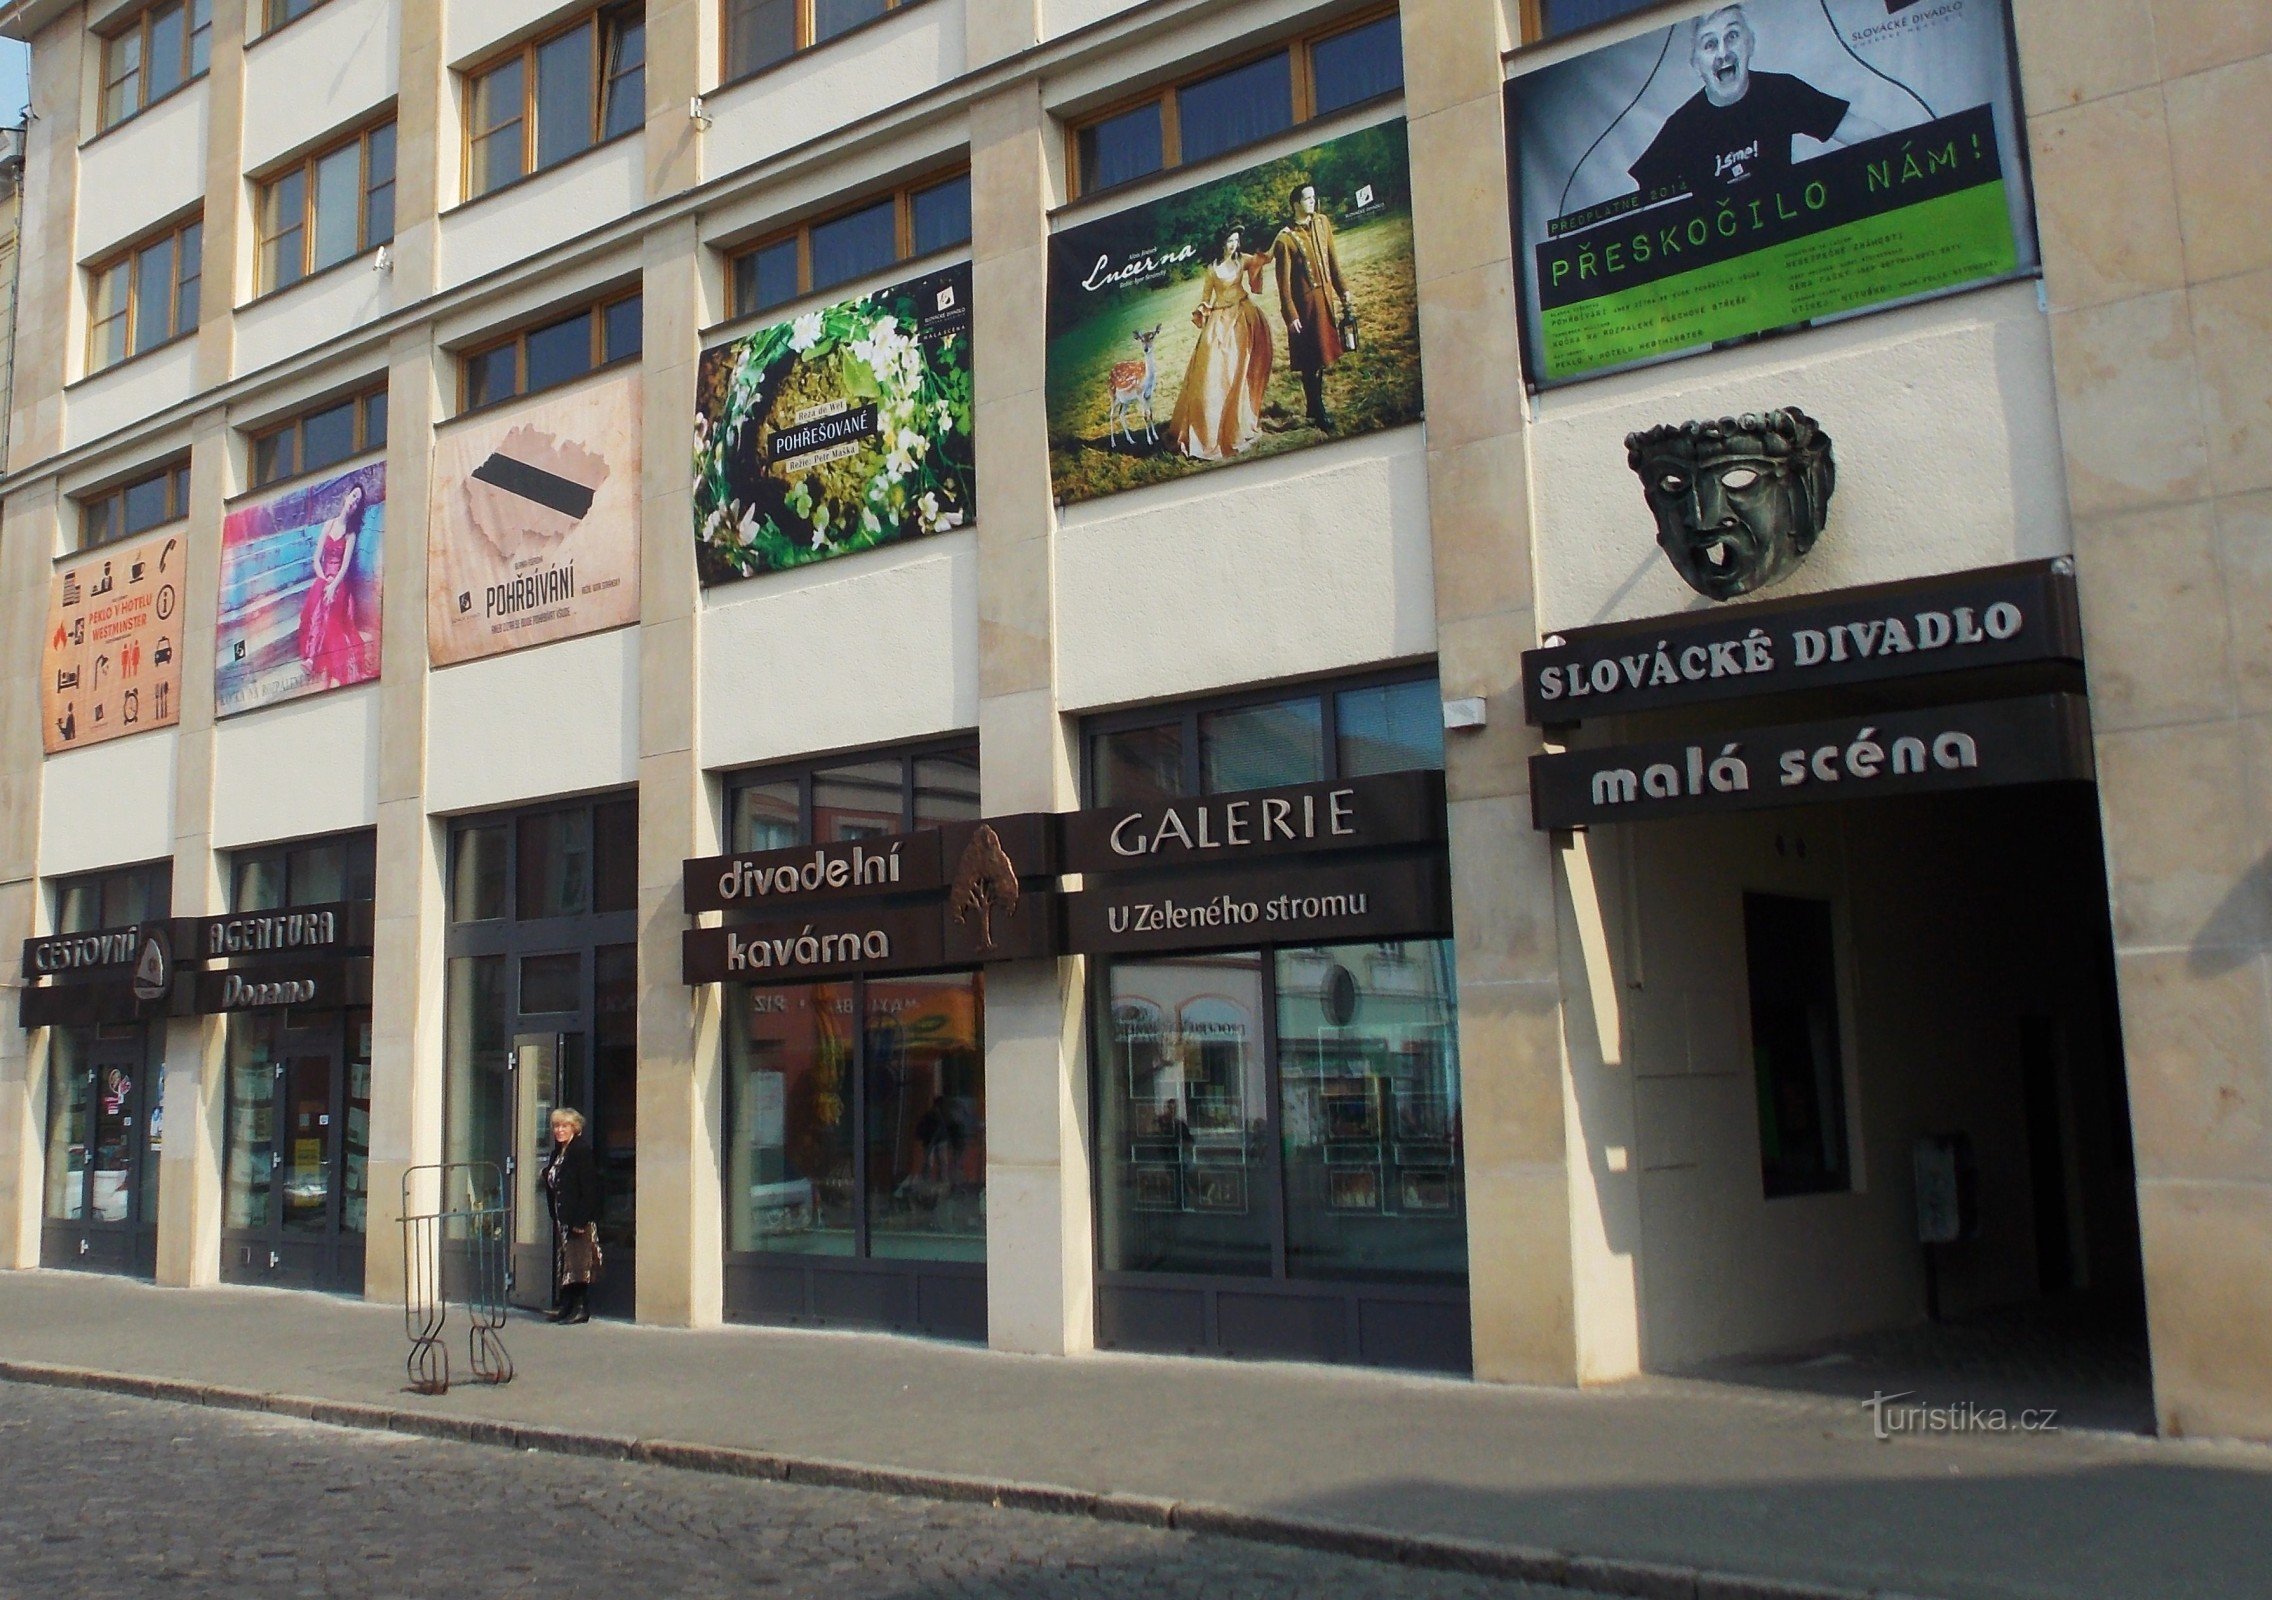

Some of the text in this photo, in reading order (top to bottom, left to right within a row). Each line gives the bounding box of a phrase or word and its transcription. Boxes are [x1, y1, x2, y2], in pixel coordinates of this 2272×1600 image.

[1912, 1, 1963, 24] DIVADLO
[1552, 181, 1828, 287] PŘESKOČILO
[1082, 244, 1197, 291] Lucerna
[776, 409, 868, 454] POHŘEŠOVANÉ
[122, 593, 152, 615] HOTELU
[486, 558, 575, 618] POHŘBÍVÁNÍ
[92, 613, 147, 642] WESTMINSTER
[1540, 602, 2022, 701] SLOVÁCKÉ DIVADLO
[1591, 726, 1978, 805] malá scéna
[1110, 788, 1357, 856] GALERIE
[719, 842, 903, 899] divadelní
[209, 911, 334, 954] AGENTURA
[1134, 894, 1260, 932] Zeleného
[1266, 891, 1368, 921] stromu
[35, 926, 138, 972] CESTOVNÍ
[728, 924, 890, 970] kavárna
